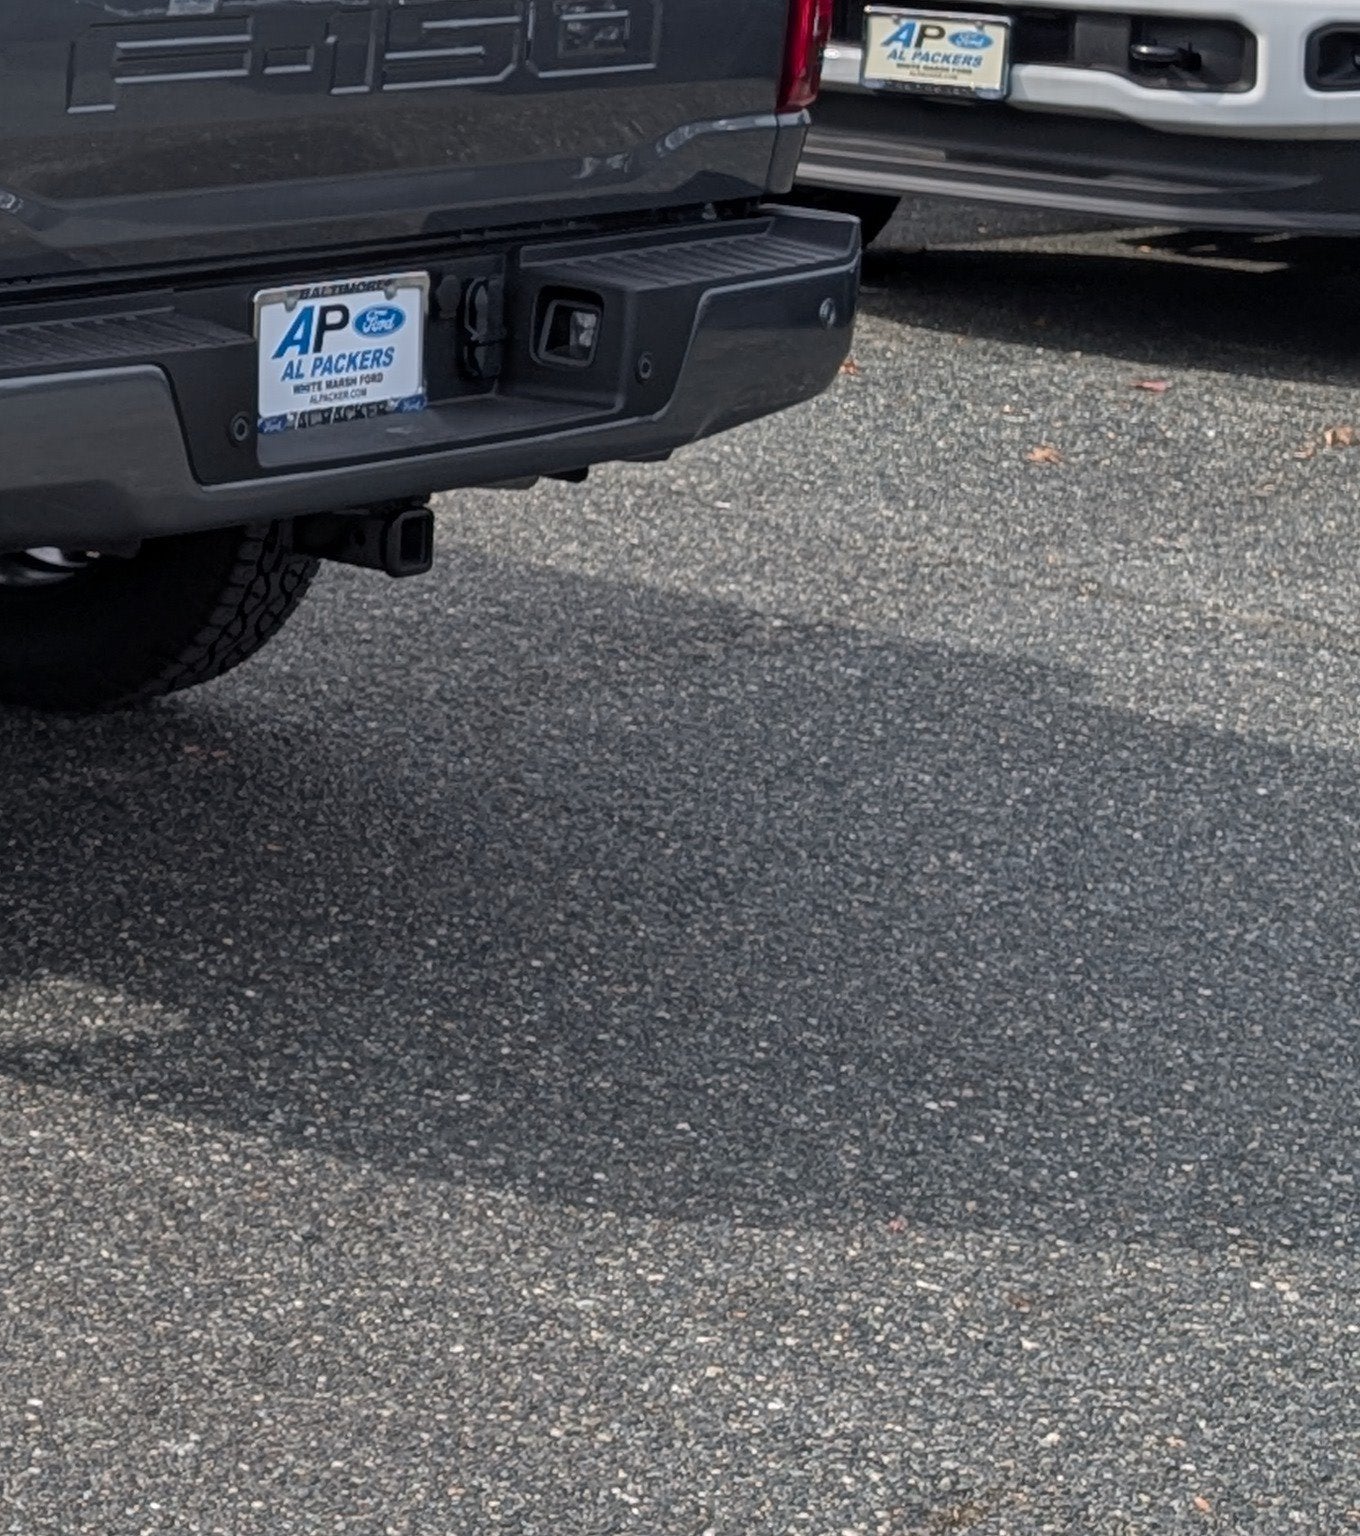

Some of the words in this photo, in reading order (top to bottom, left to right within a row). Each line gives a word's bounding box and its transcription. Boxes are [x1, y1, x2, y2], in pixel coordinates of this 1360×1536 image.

[880, 21, 946, 49] AP
[887, 48, 906, 61] AL
[911, 50, 984, 68] PACKERS
[272, 305, 350, 360] AP
[280, 360, 305, 382] AL
[310, 346, 396, 378] PACKERS
[292, 381, 322, 395] WHITE
[325, 375, 357, 390] MARSH
[359, 373, 383, 386] FORD
[309, 388, 367, 404] ALPACKER.COM
